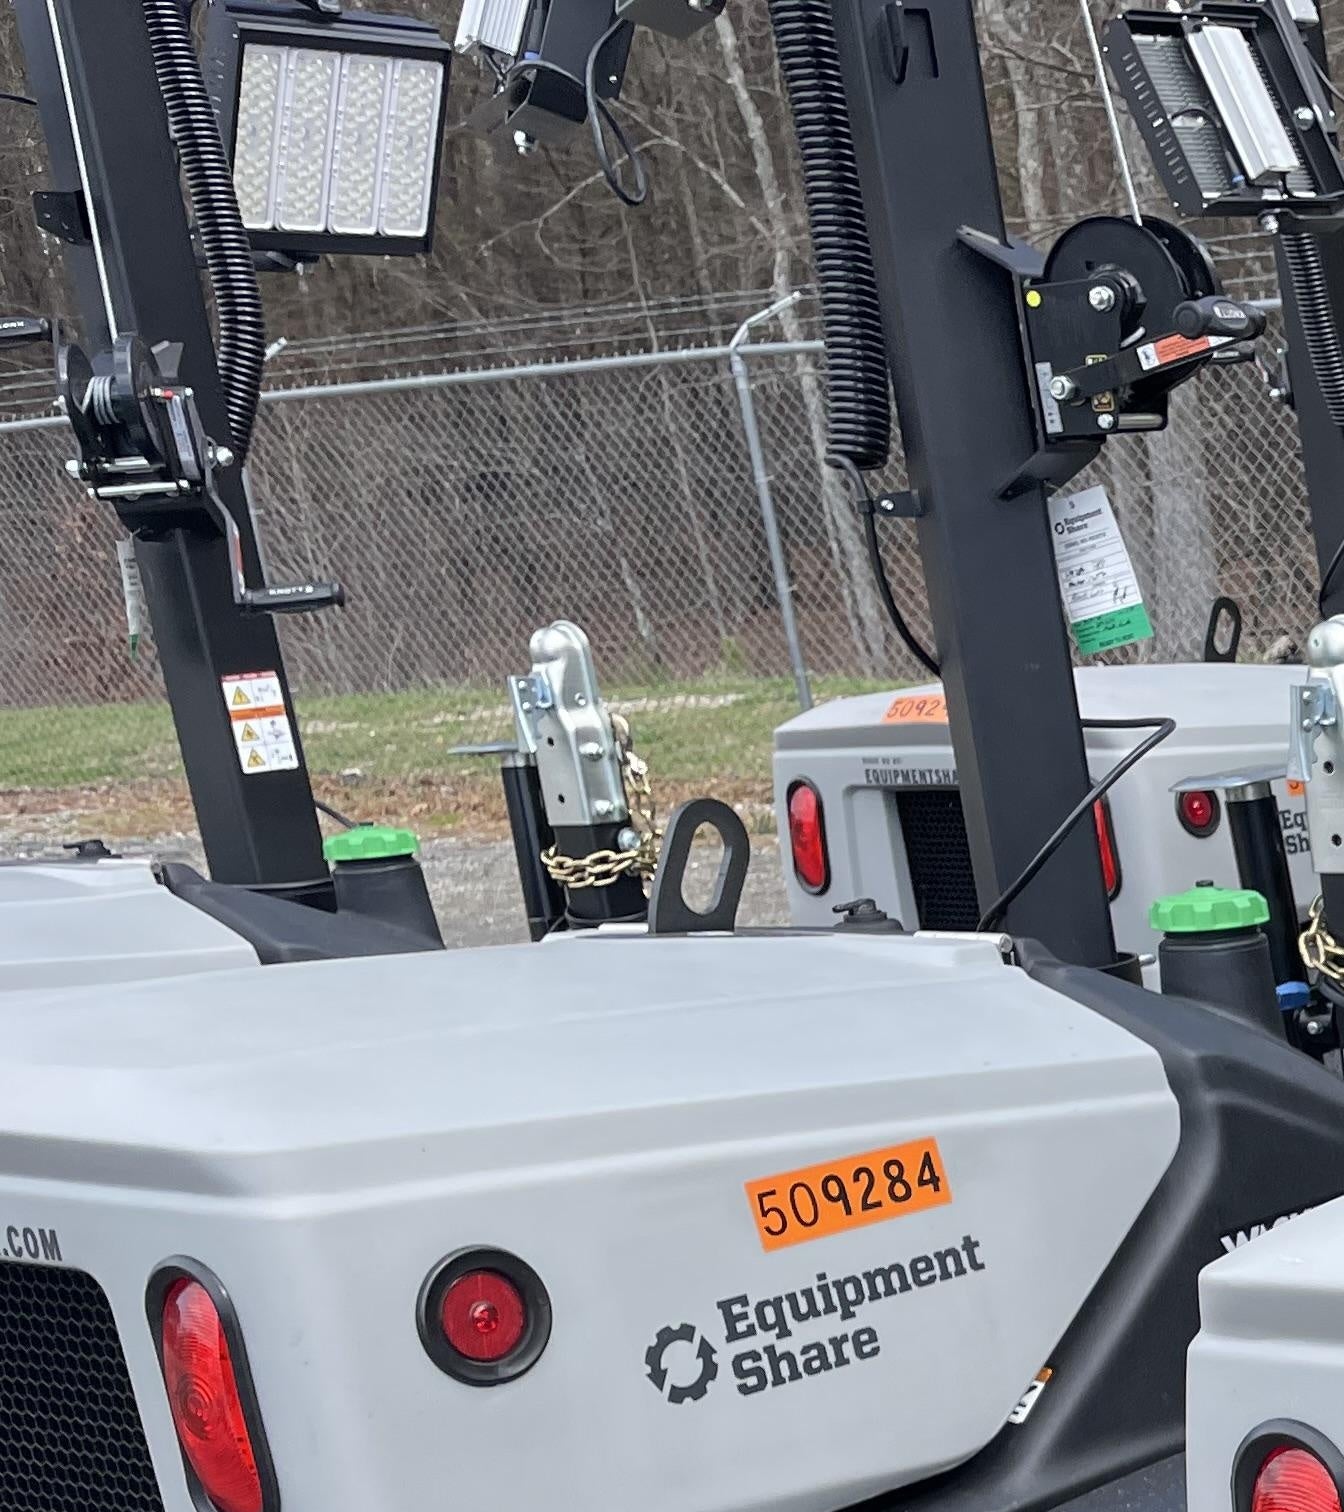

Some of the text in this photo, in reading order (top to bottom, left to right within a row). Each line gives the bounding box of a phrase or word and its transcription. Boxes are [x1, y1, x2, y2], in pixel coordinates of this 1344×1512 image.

[887, 698, 946, 718] 5092
[756, 1150, 941, 1237] 509284
[716, 1234, 986, 1344] Equipment
[731, 1325, 881, 1397] Share
